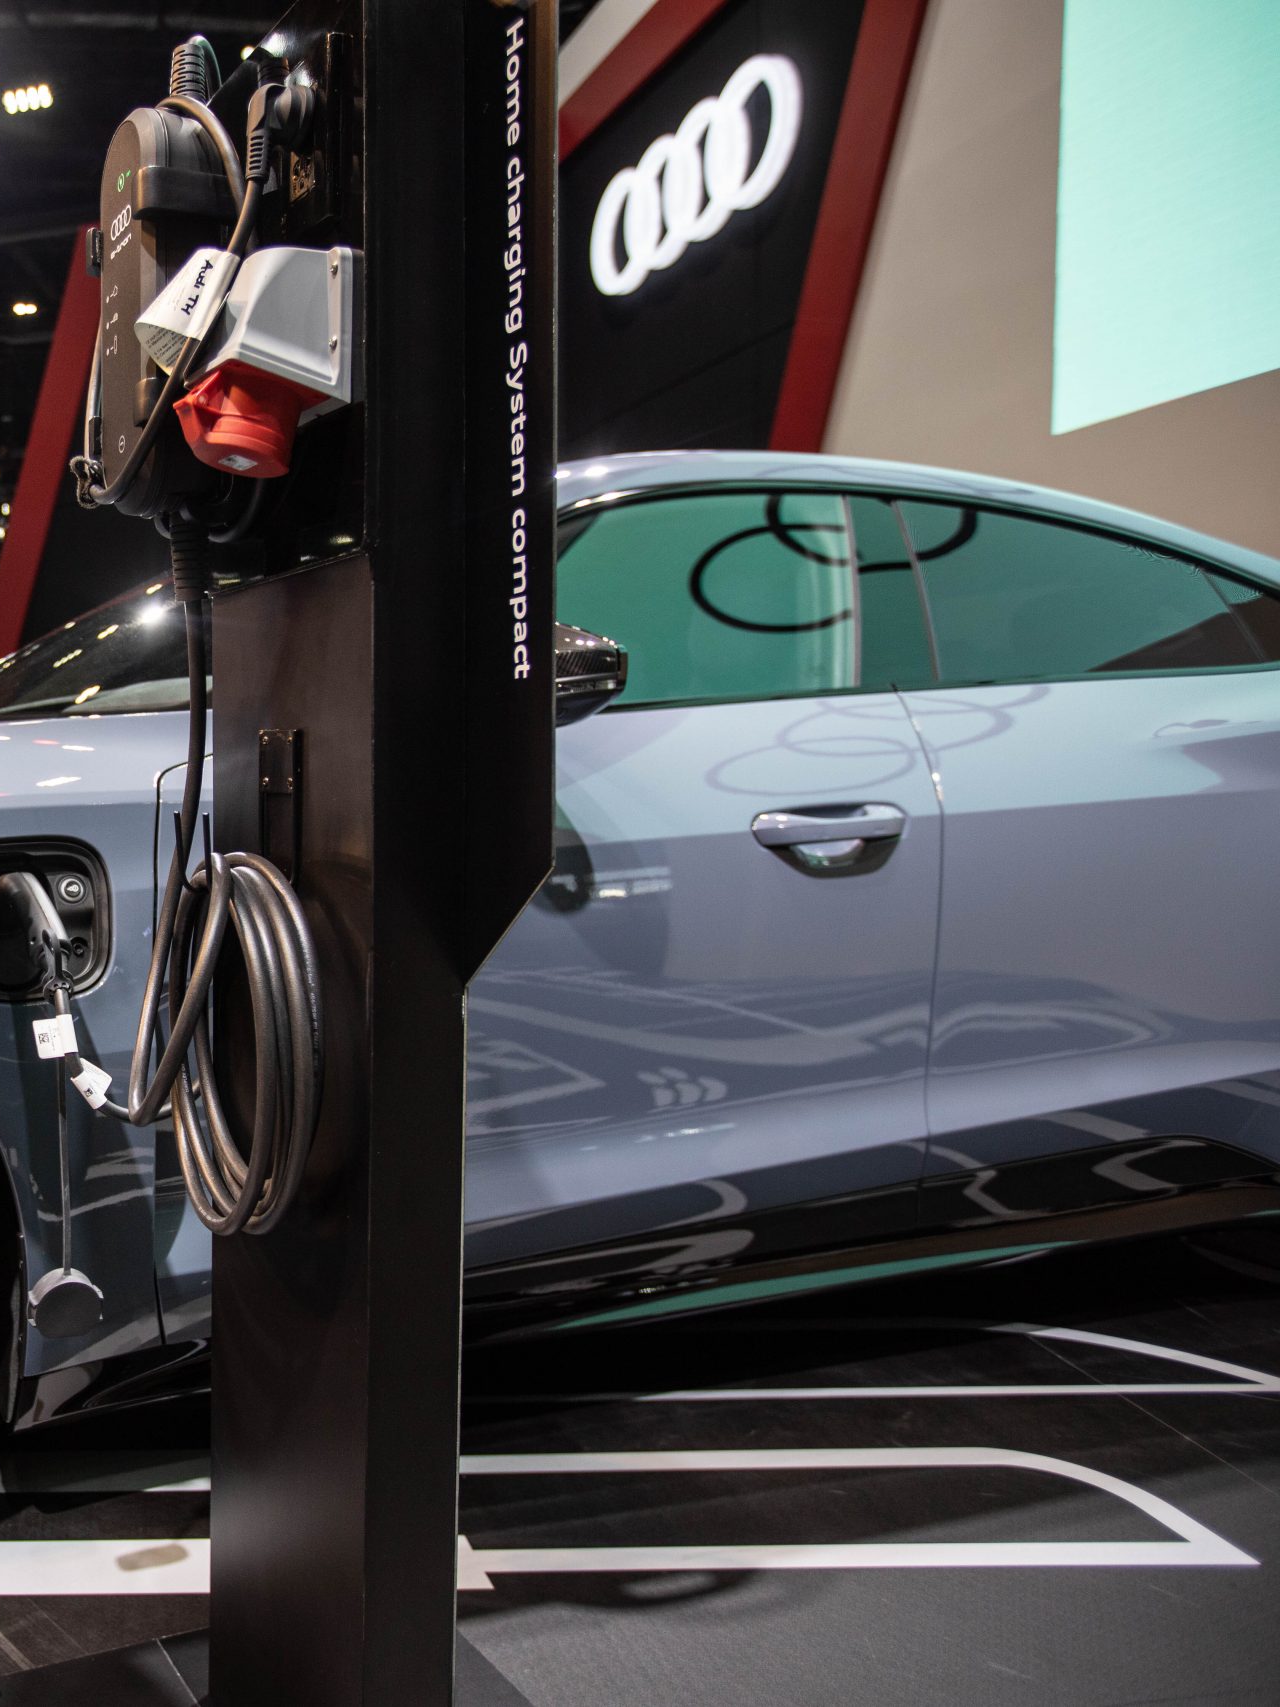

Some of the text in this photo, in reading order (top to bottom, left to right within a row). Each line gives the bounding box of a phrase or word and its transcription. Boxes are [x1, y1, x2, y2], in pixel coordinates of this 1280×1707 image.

[181, 259, 214, 316] Audi TH
[504, 18, 530, 680] Home charging System compact
